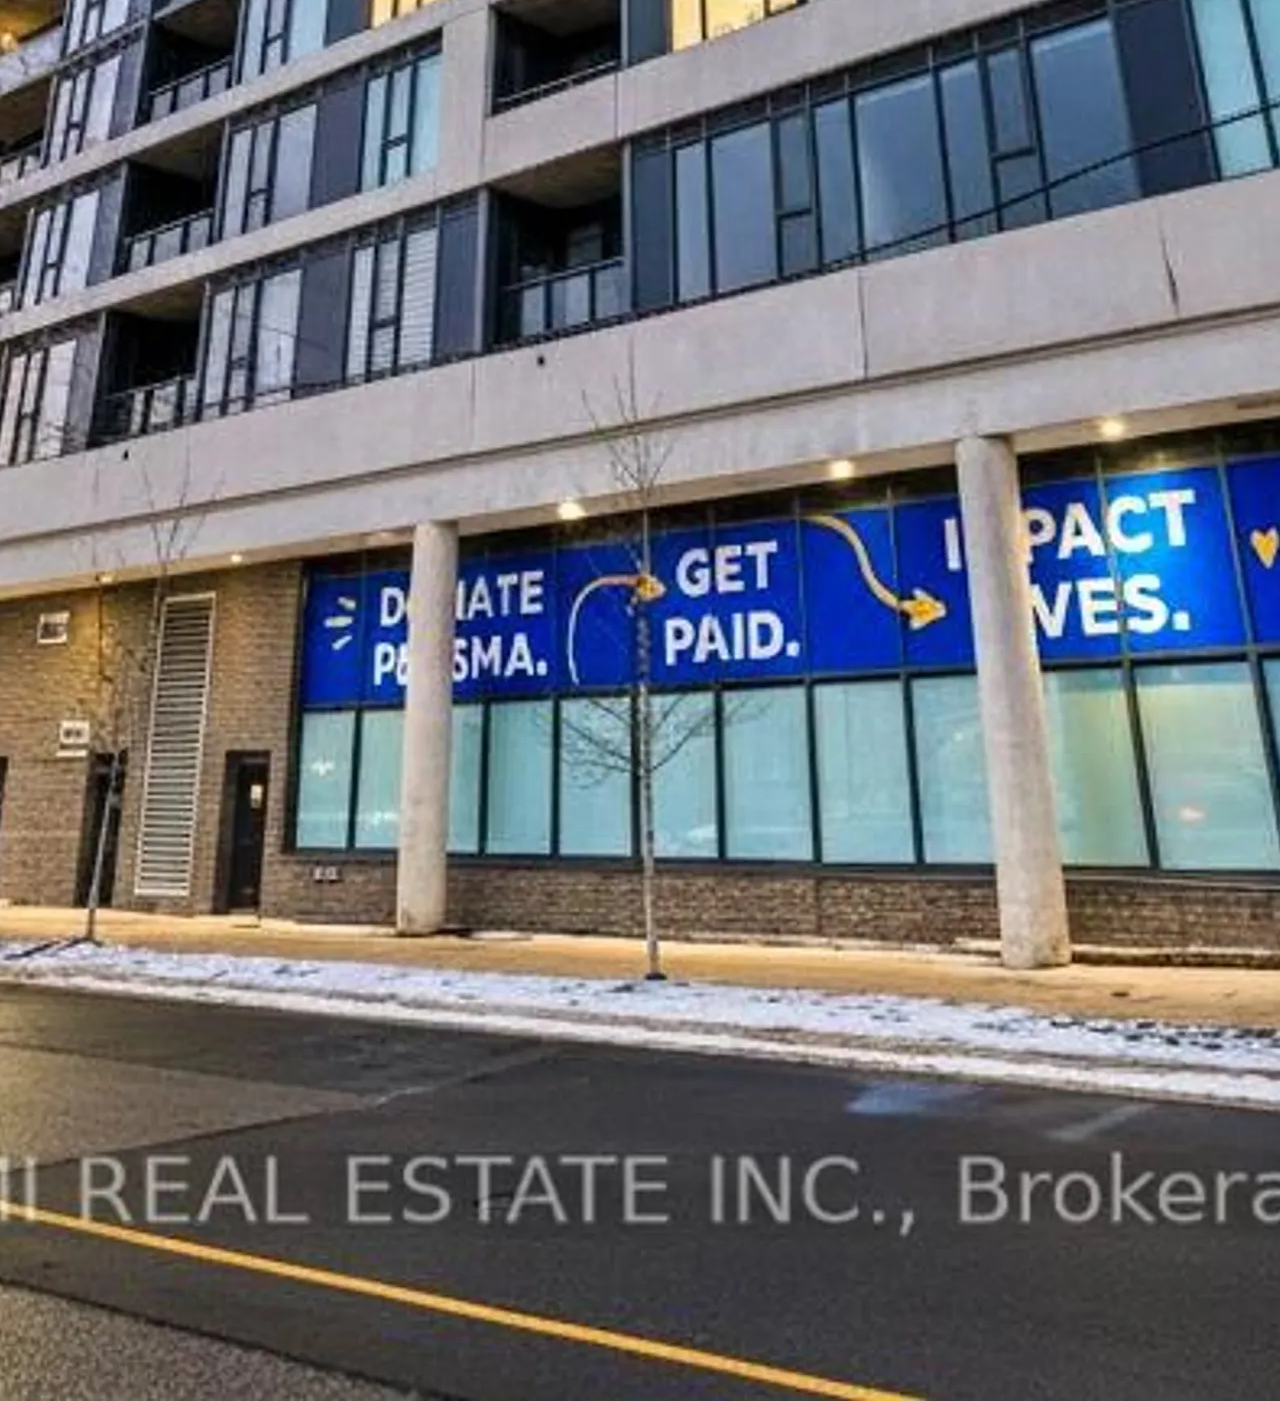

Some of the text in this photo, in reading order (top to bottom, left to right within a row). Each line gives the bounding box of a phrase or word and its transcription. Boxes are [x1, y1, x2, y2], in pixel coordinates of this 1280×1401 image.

[944, 489, 1195, 571] IPACT
[676, 540, 778, 597] GET
[380, 571, 545, 627] DATE
[1031, 573, 1191, 639] VES.
[373, 632, 549, 686] PSMA.
[664, 609, 801, 667] PAID.
